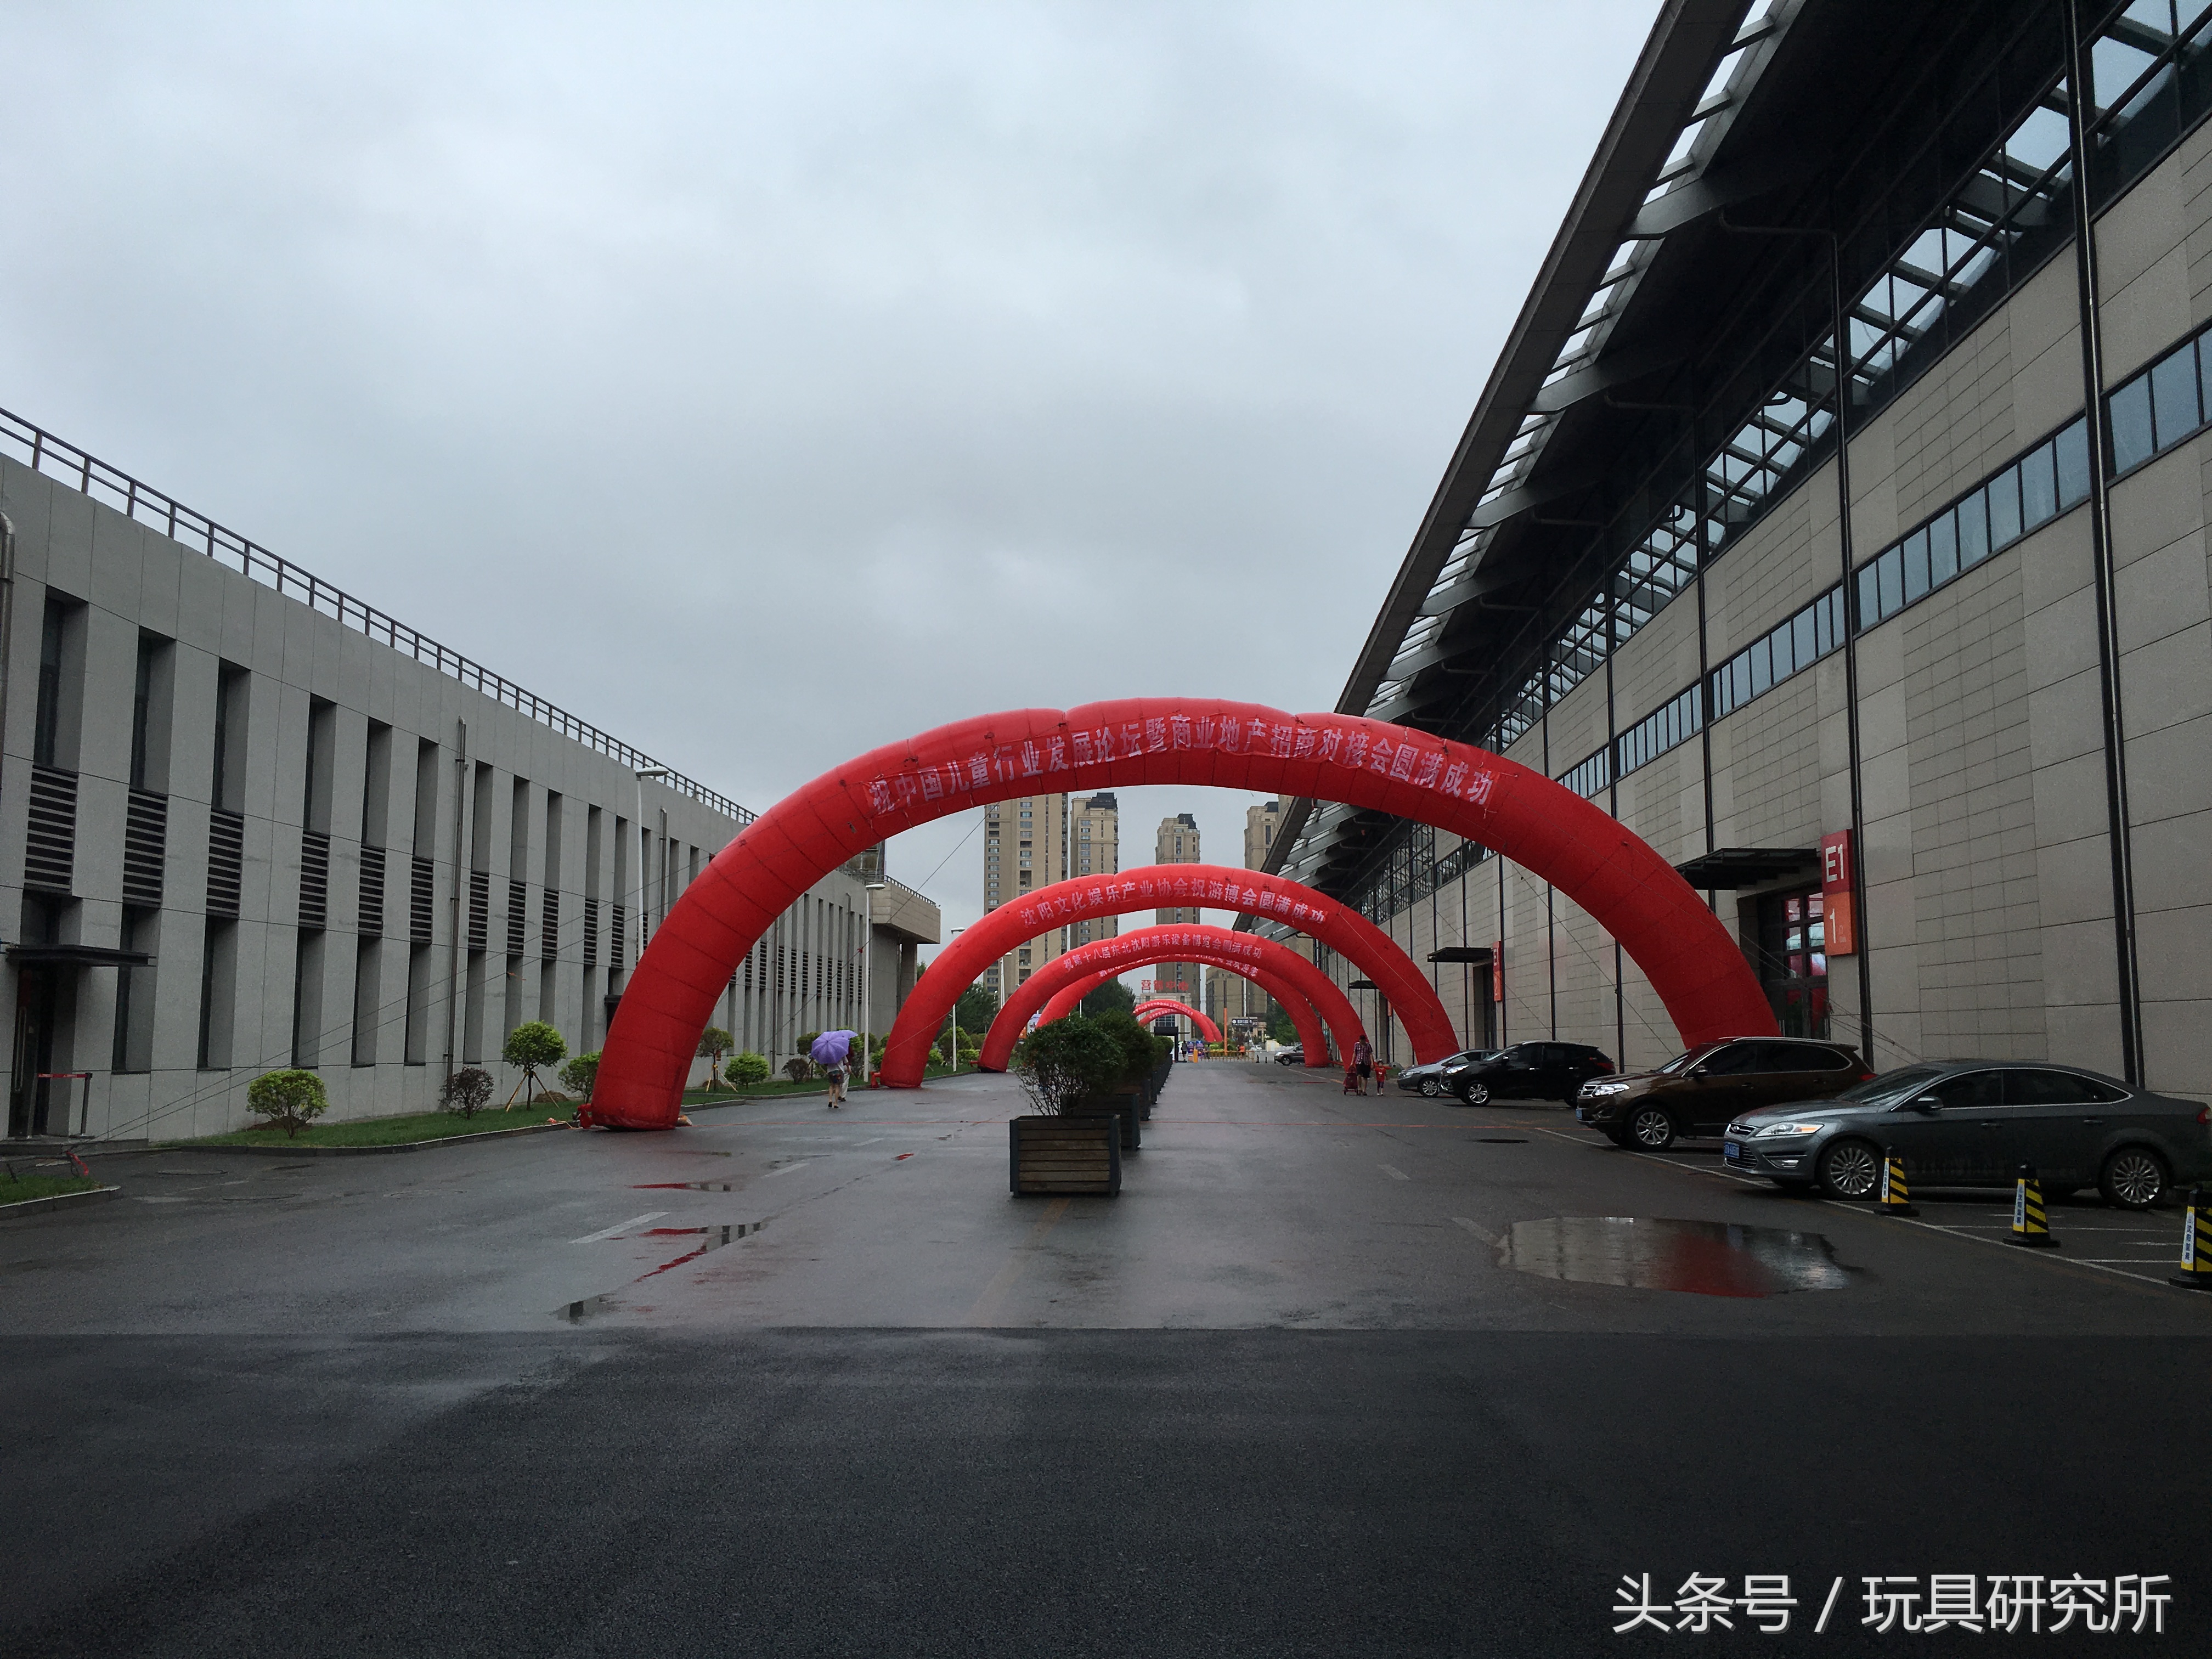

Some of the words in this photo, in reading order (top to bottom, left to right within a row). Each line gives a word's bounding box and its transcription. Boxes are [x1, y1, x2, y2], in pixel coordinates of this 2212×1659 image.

[868, 713, 1493, 815] 祝中国儿童行业发展论坛暨商业地产招商对接会圆满成功
[1825, 844, 1844, 883] E1
[1020, 877, 1325, 927] 沈阳文化娱乐产业协会祝游博会圆满成功
[1829, 907, 1837, 944] 1
[1063, 933, 1262, 972] 祝第十八届东北沈阳游乐设备博览会圆满成功
